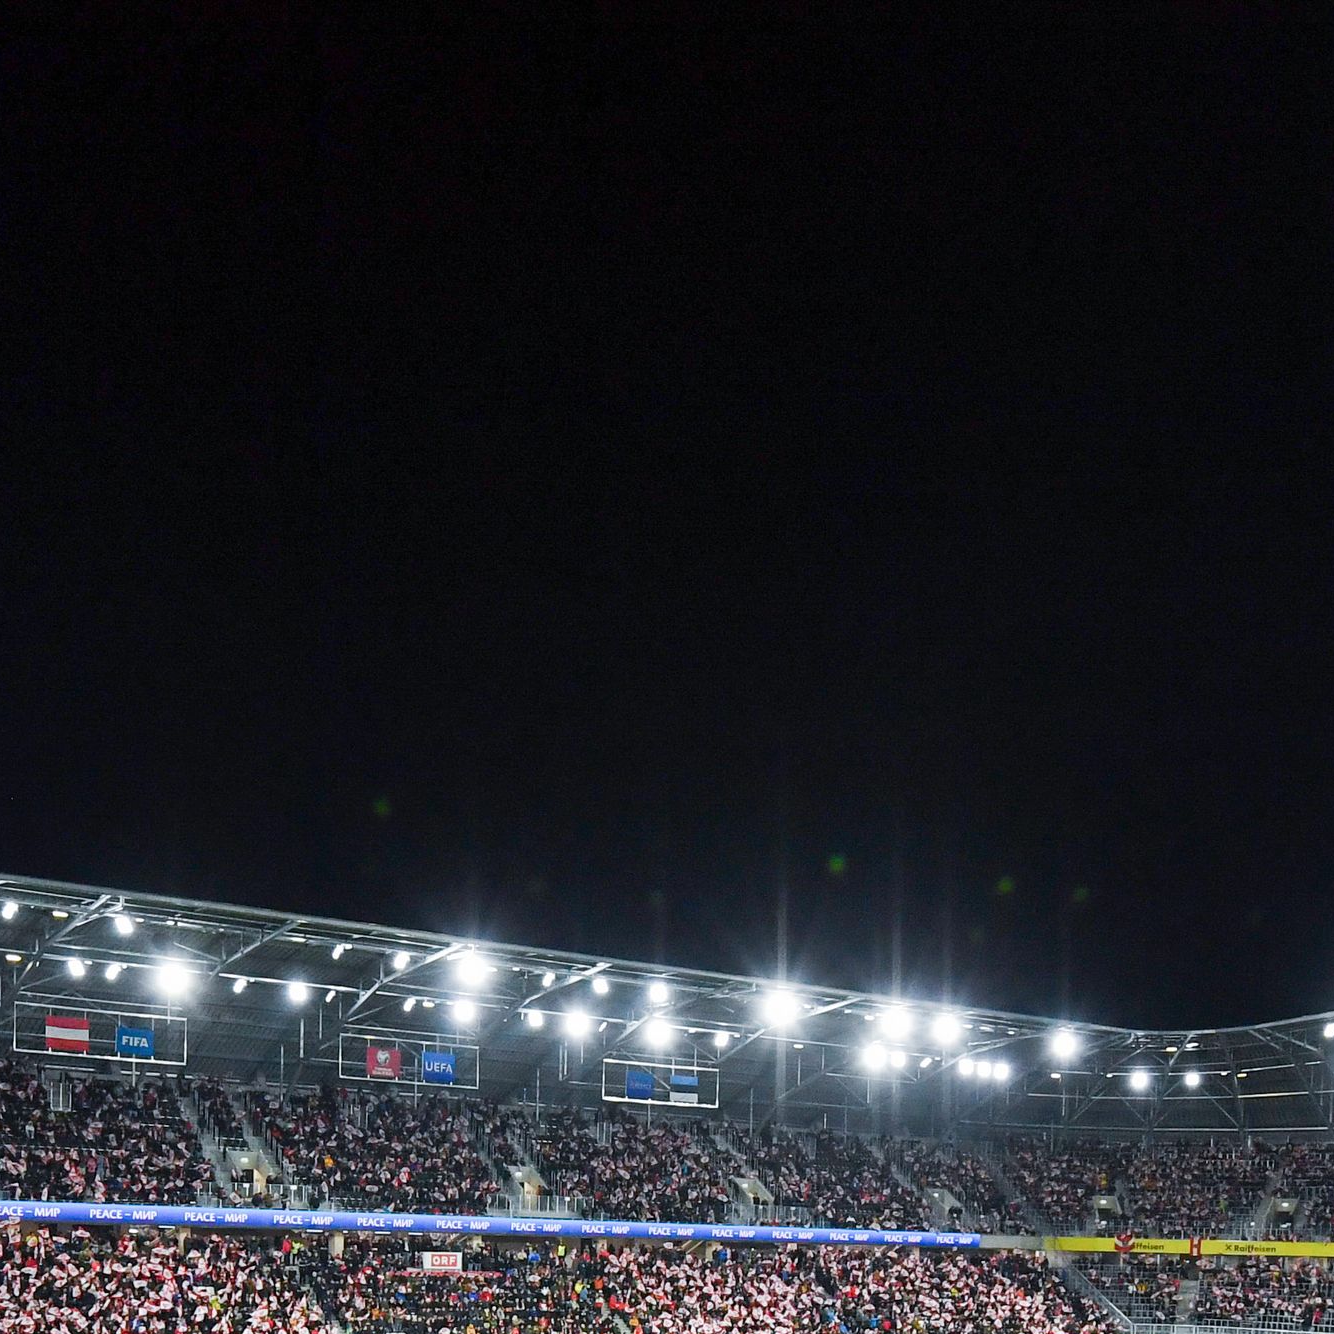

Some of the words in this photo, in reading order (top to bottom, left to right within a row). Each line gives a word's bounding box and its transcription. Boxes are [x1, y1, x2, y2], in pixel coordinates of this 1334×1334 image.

[122, 1035, 149, 1048] FIFA
[425, 1061, 453, 1076] UEFA
[34, 1207, 60, 1217] МИР
[90, 1209, 122, 1219] PEACE
[132, 1210, 157, 1220] МИР
[184, 1212, 215, 1222] PEACE
[225, 1213, 248, 1223] МИР
[273, 1215, 303, 1224] PEACE
[311, 1216, 333, 1225] МИР
[357, 1217, 385, 1227] PEACE
[393, 1218, 414, 1228] МИР
[436, 1220, 463, 1229] PEACE
[511, 1222, 535, 1231] PEACE
[581, 1225, 605, 1233] PEACE
[648, 1227, 671, 1235] PEACE
[712, 1229, 733, 1237] PEACE
[772, 1231, 792, 1239] PEACE
[433, 1255, 456, 1266] ORF
